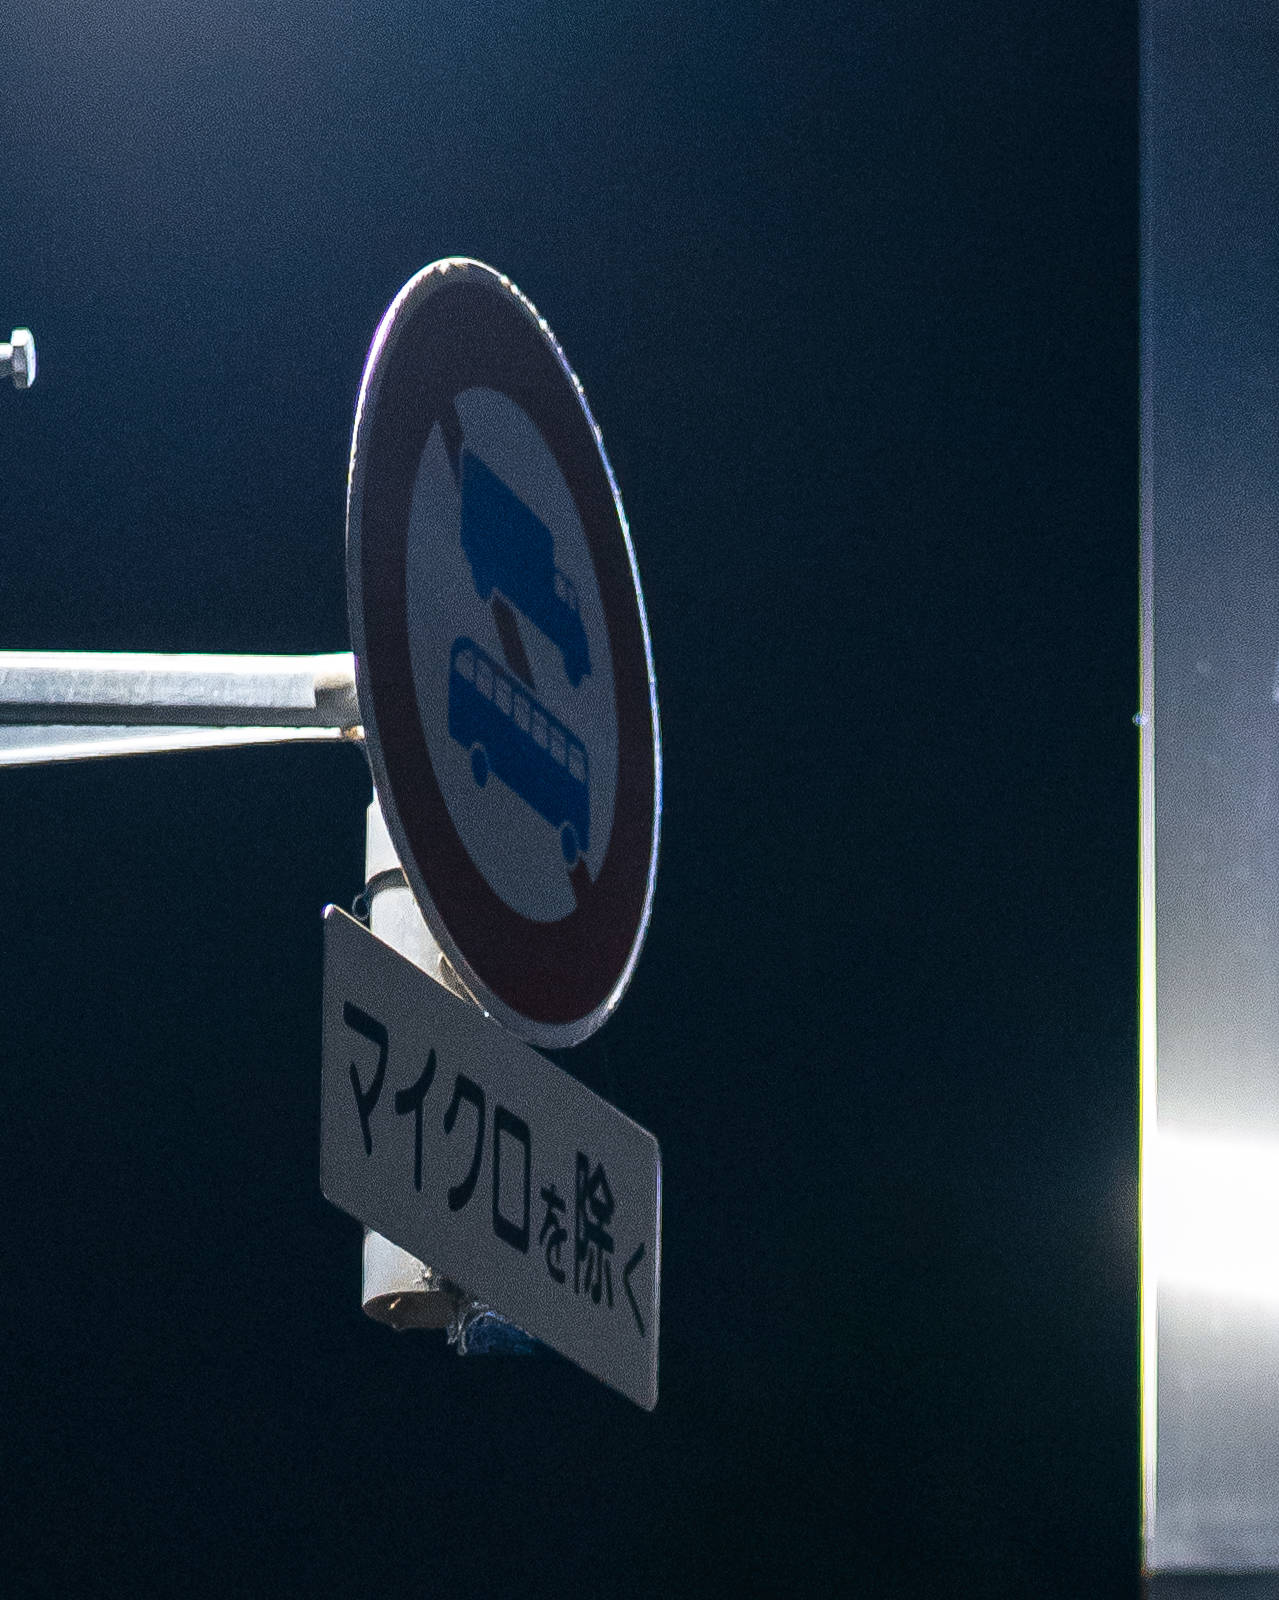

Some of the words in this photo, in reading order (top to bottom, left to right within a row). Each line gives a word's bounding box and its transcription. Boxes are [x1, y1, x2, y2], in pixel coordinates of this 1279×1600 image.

[343, 1000, 646, 1338] マイクロを除く
